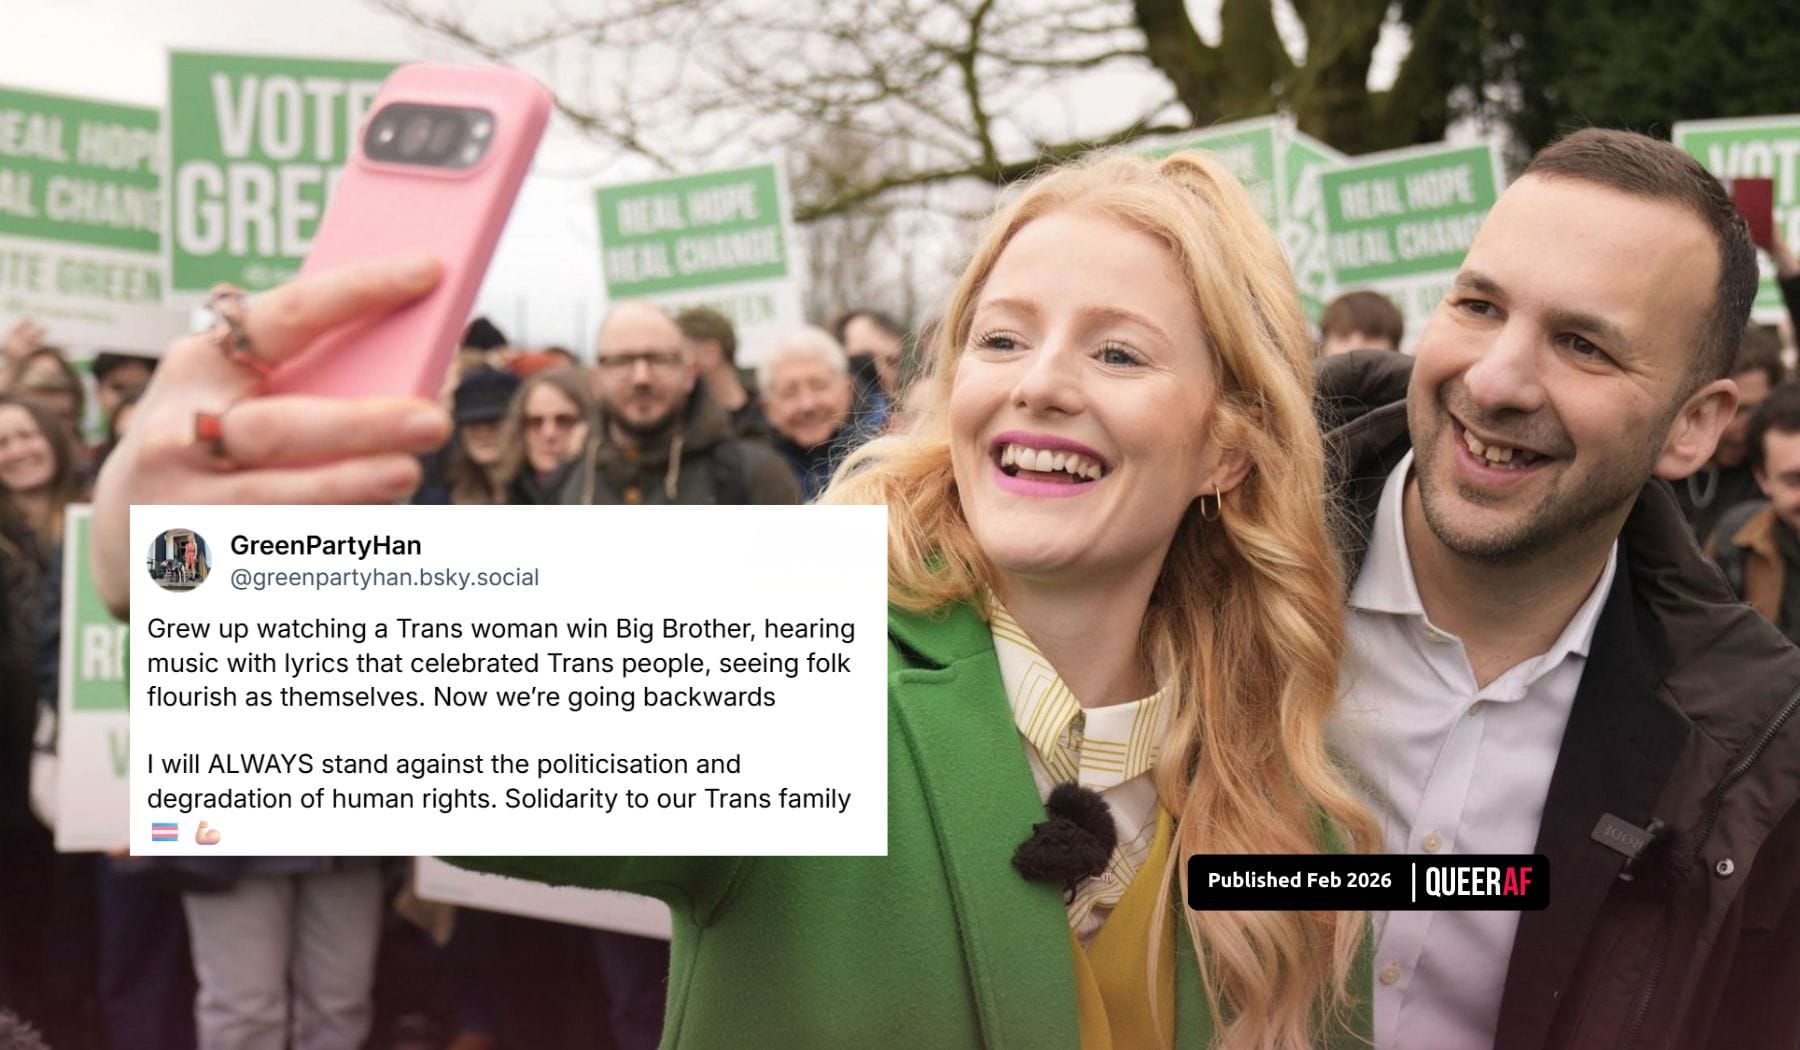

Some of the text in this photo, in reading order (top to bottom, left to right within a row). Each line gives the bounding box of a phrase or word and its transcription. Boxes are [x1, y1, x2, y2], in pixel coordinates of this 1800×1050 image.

[0, 110, 68, 162] EAL
[176, 160, 346, 256] GRE
[617, 181, 757, 235] REAL HOPE
[1339, 164, 1476, 222] REAL HOPE
[608, 243, 673, 282] REAL
